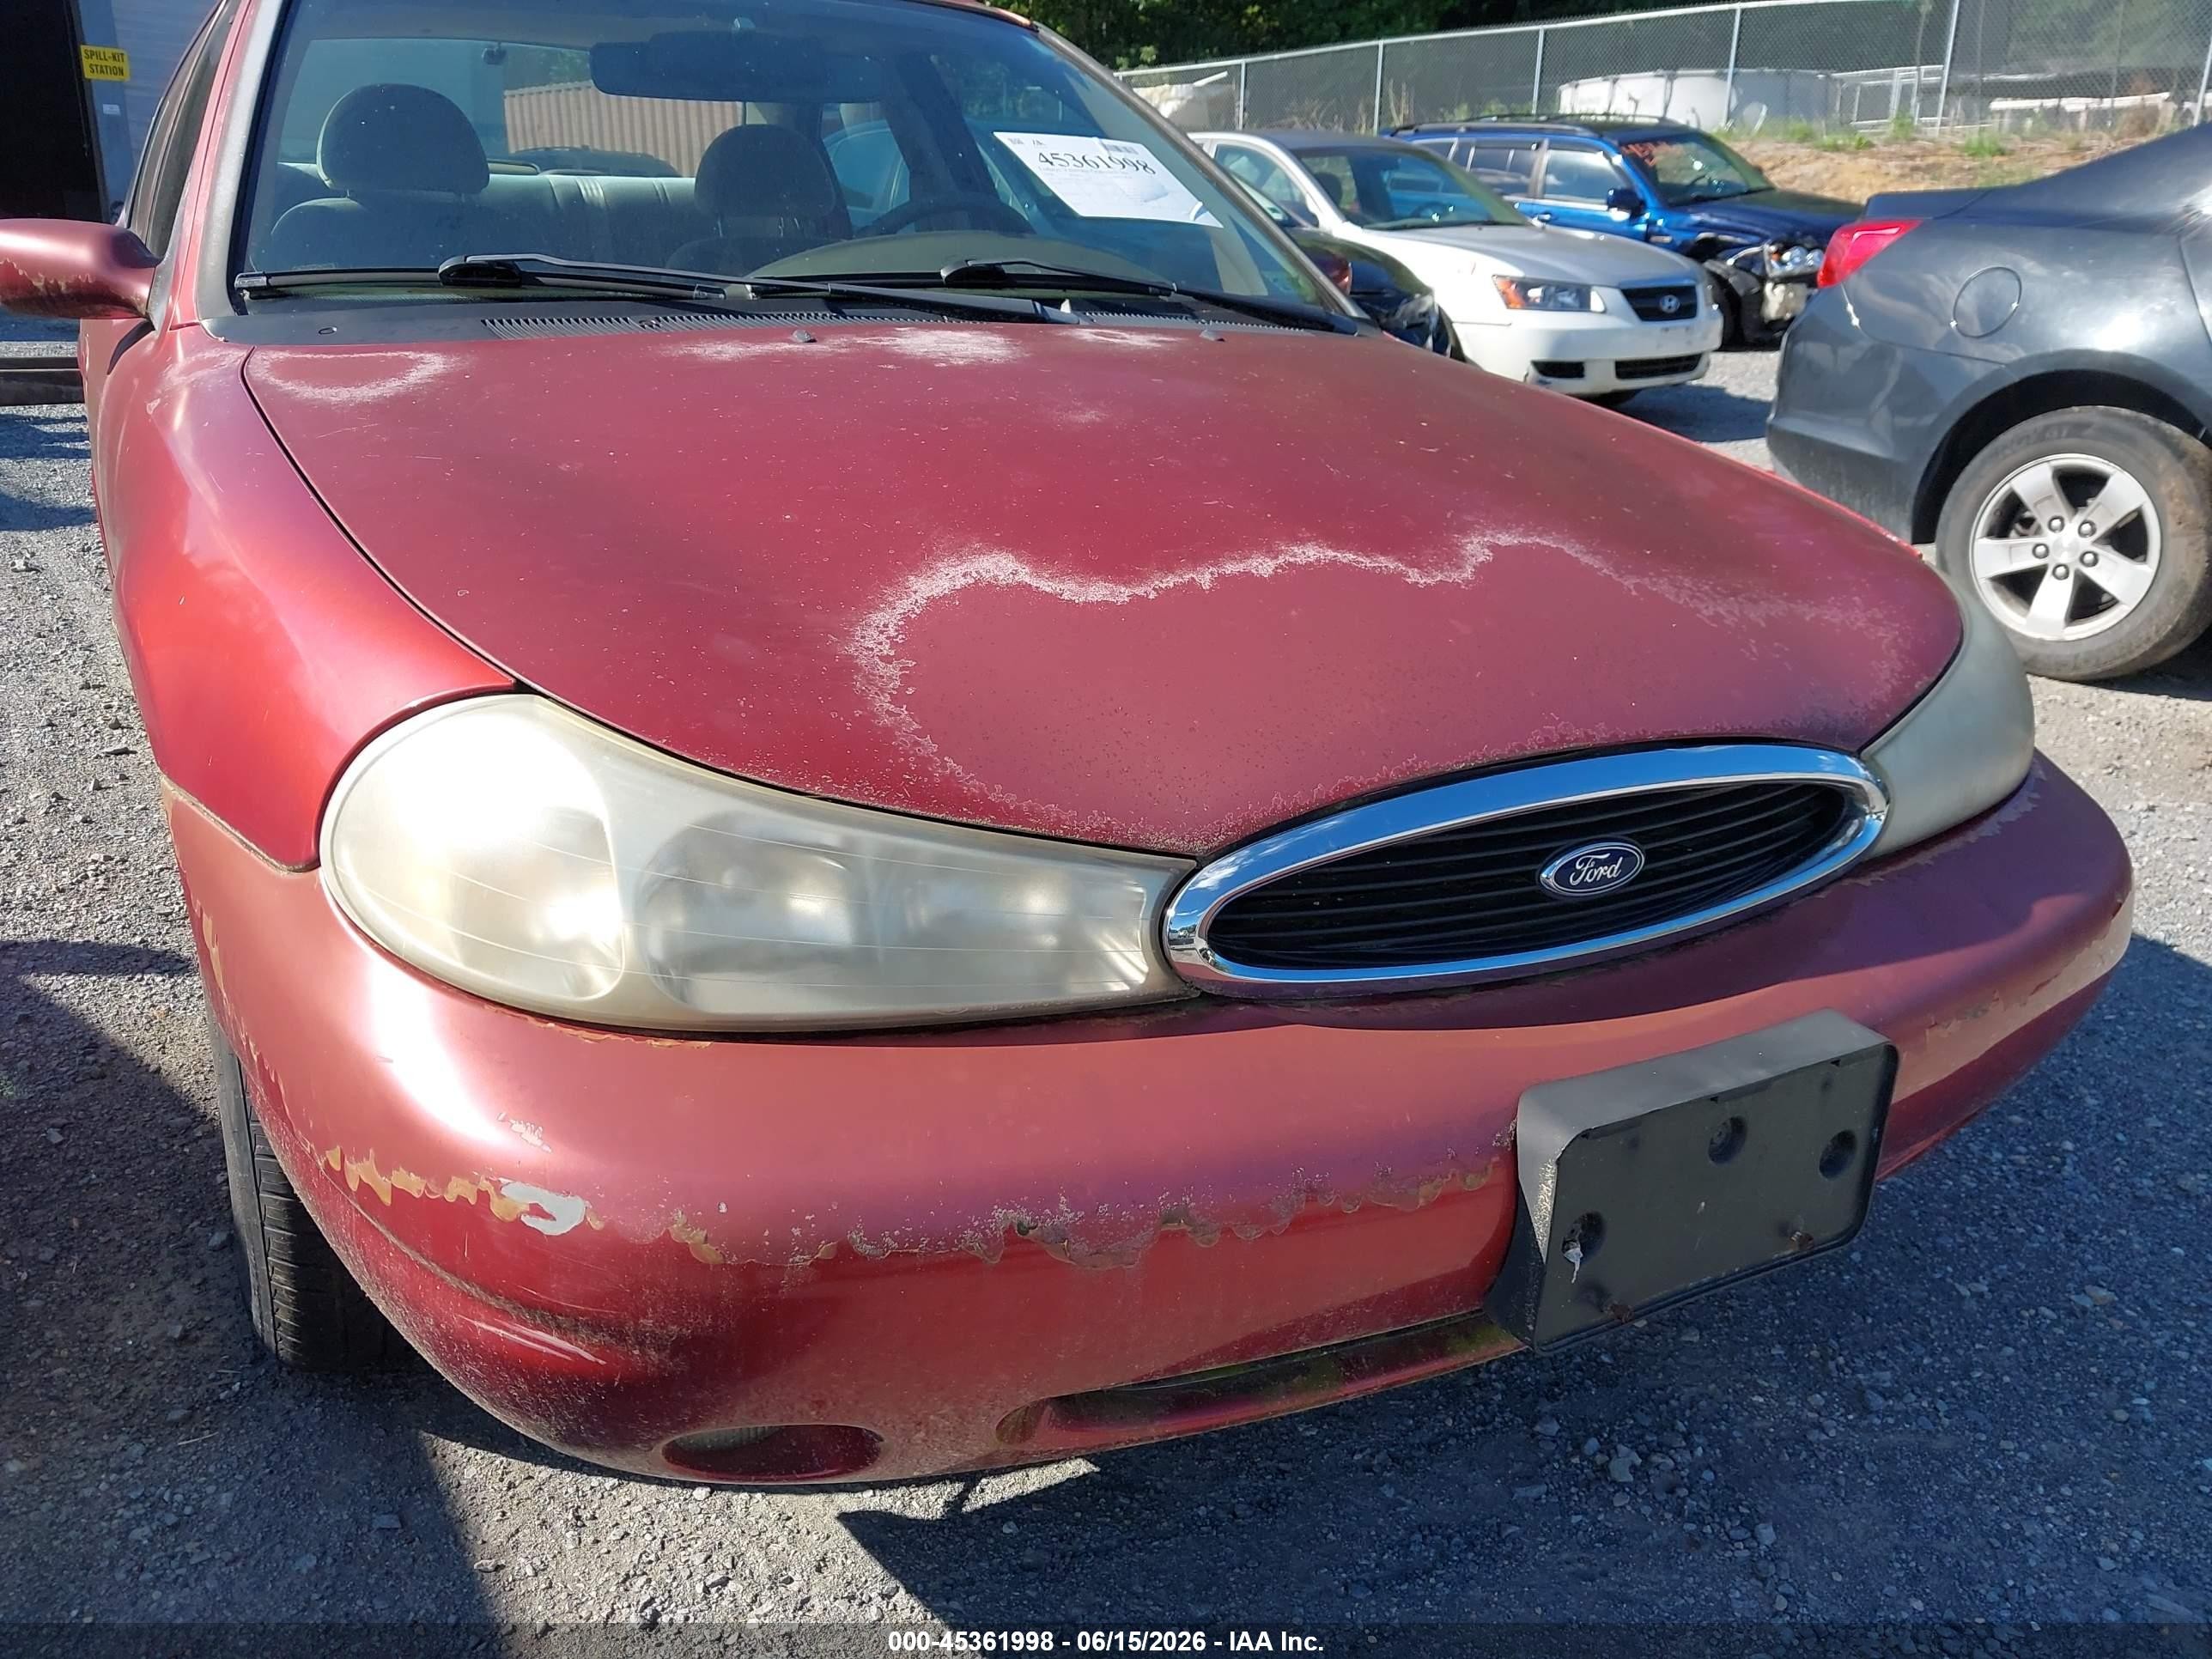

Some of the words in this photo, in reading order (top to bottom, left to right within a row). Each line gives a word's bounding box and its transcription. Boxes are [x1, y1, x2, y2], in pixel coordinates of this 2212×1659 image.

[83, 49, 125, 63] SPILL-KIT
[89, 64, 125, 76] STATION
[1038, 152, 1157, 175] 45361998
[1570, 853, 1624, 886] Ford
